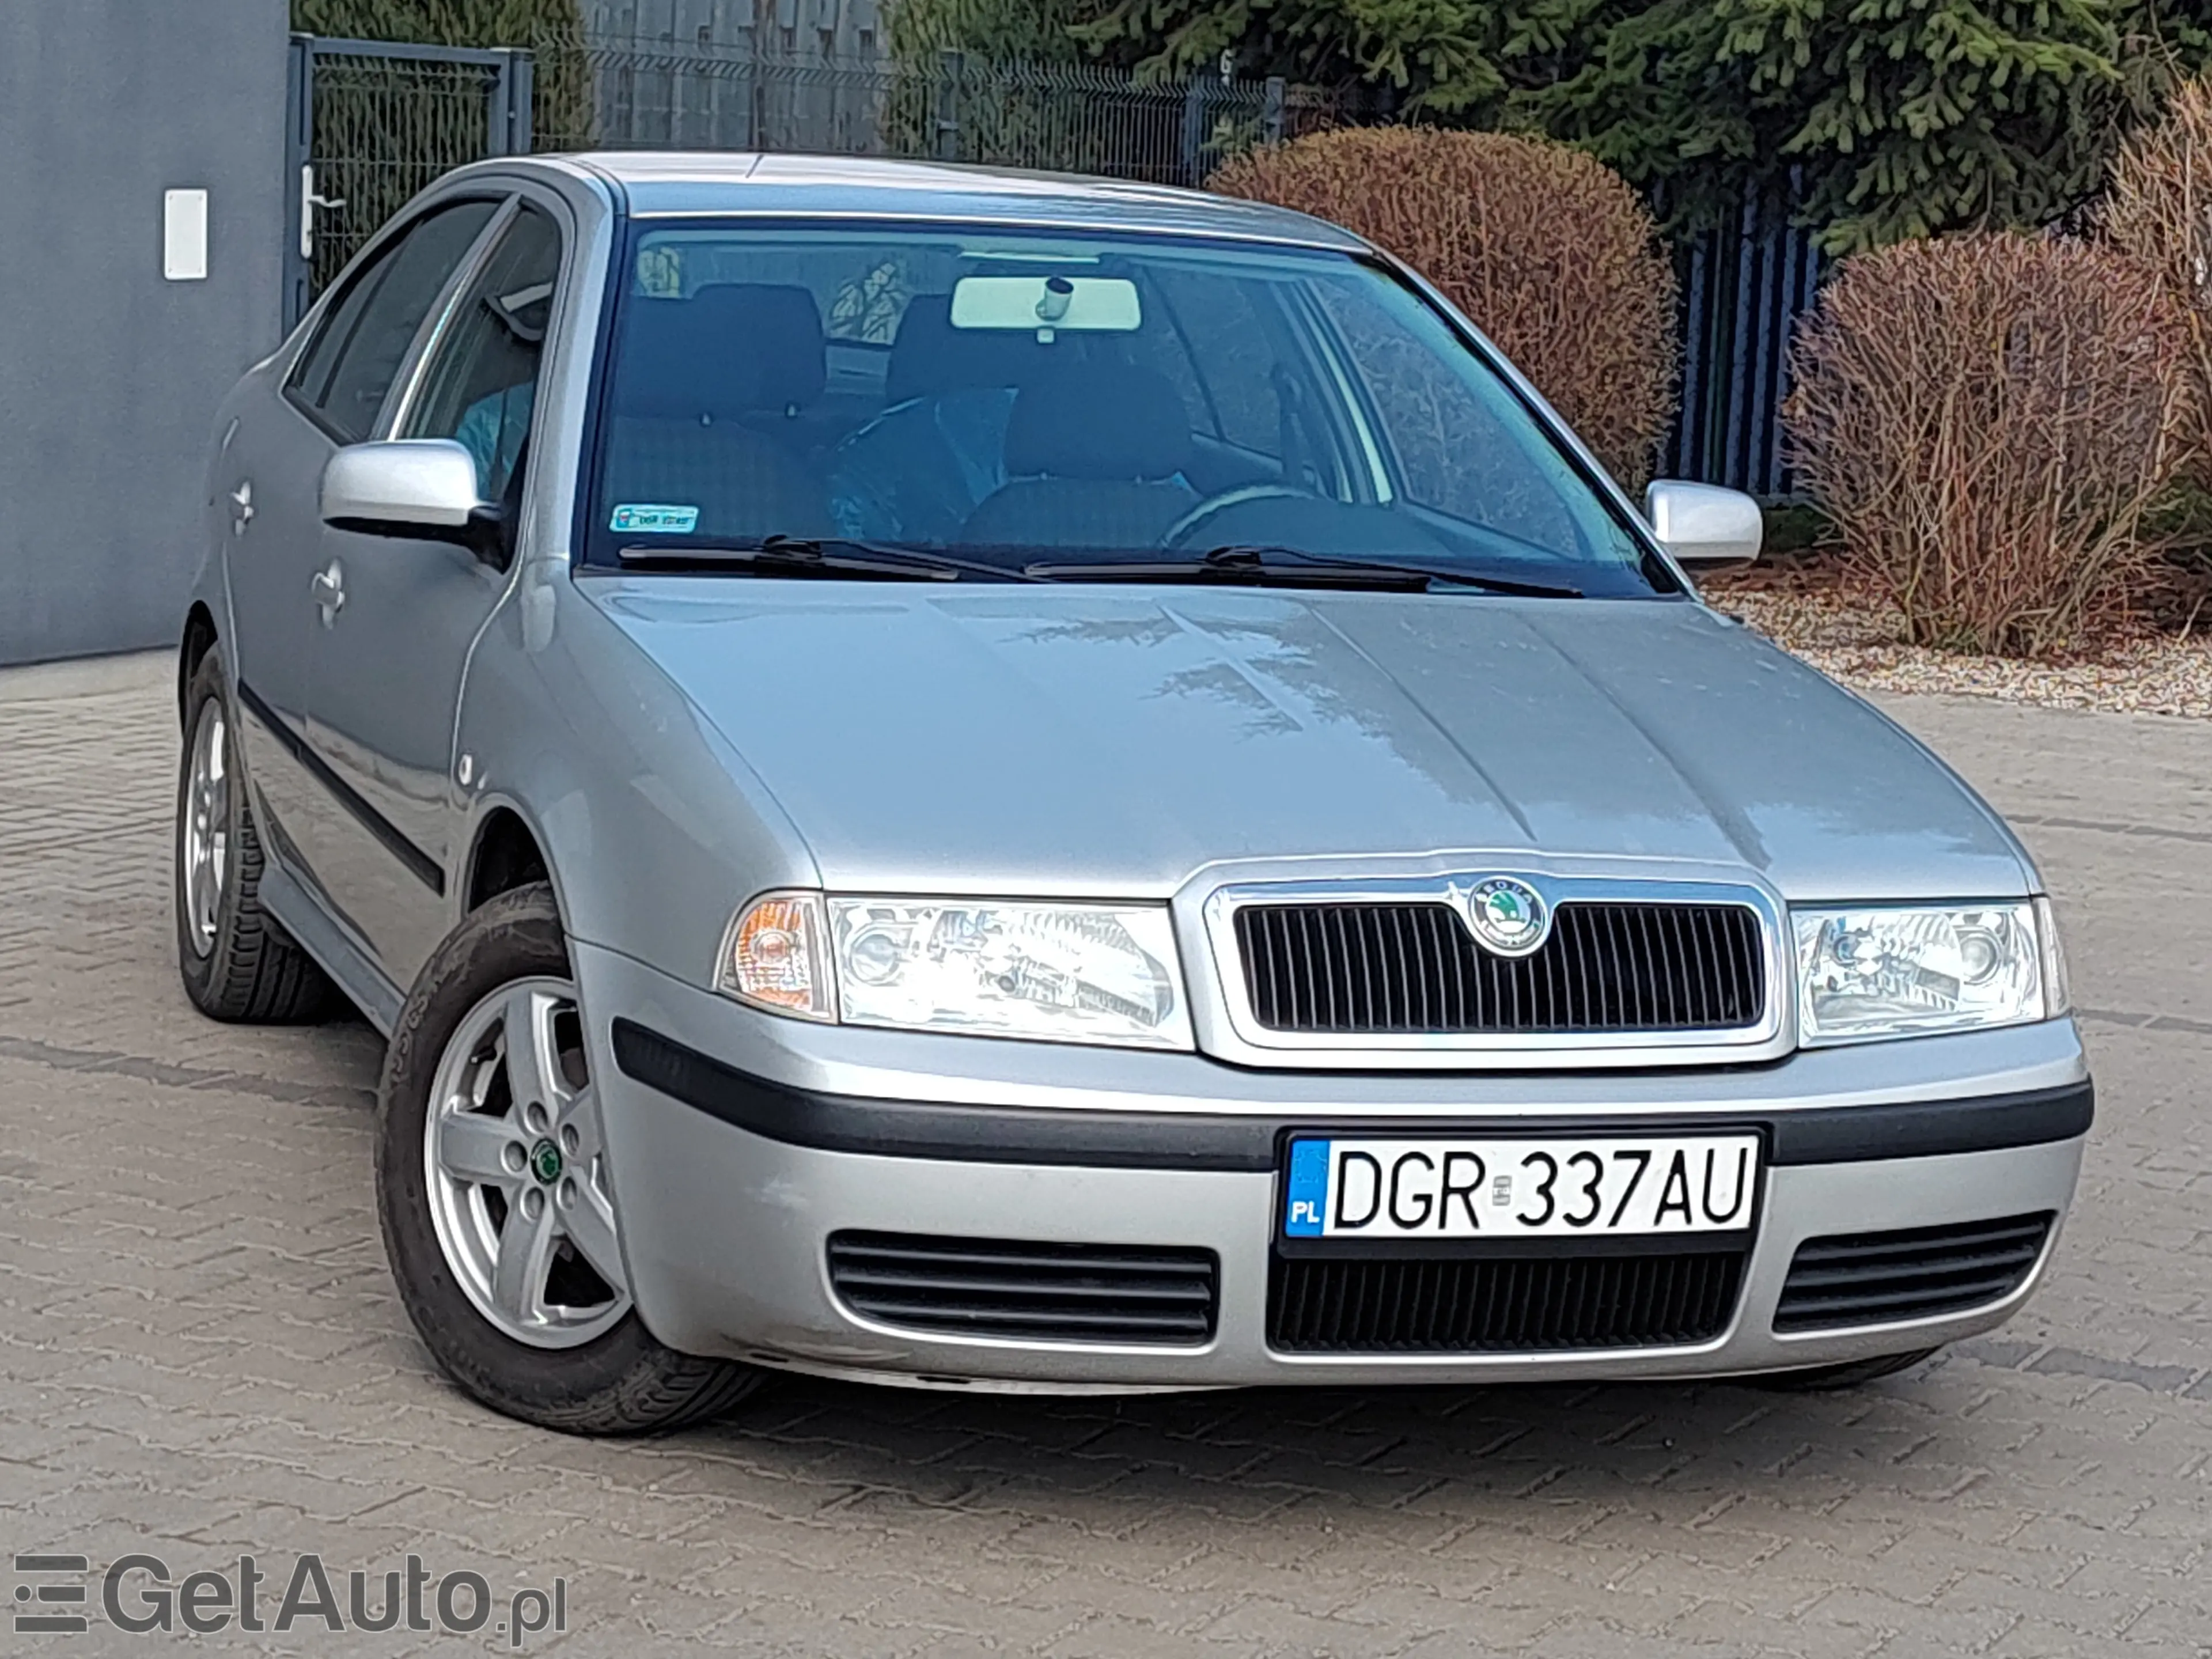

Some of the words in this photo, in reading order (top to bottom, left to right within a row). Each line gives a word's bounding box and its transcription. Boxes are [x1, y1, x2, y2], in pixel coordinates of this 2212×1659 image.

[1290, 1200, 1320, 1224] PL
[1334, 1150, 1486, 1230] DGR
[1516, 1147, 1748, 1228] 337AU
